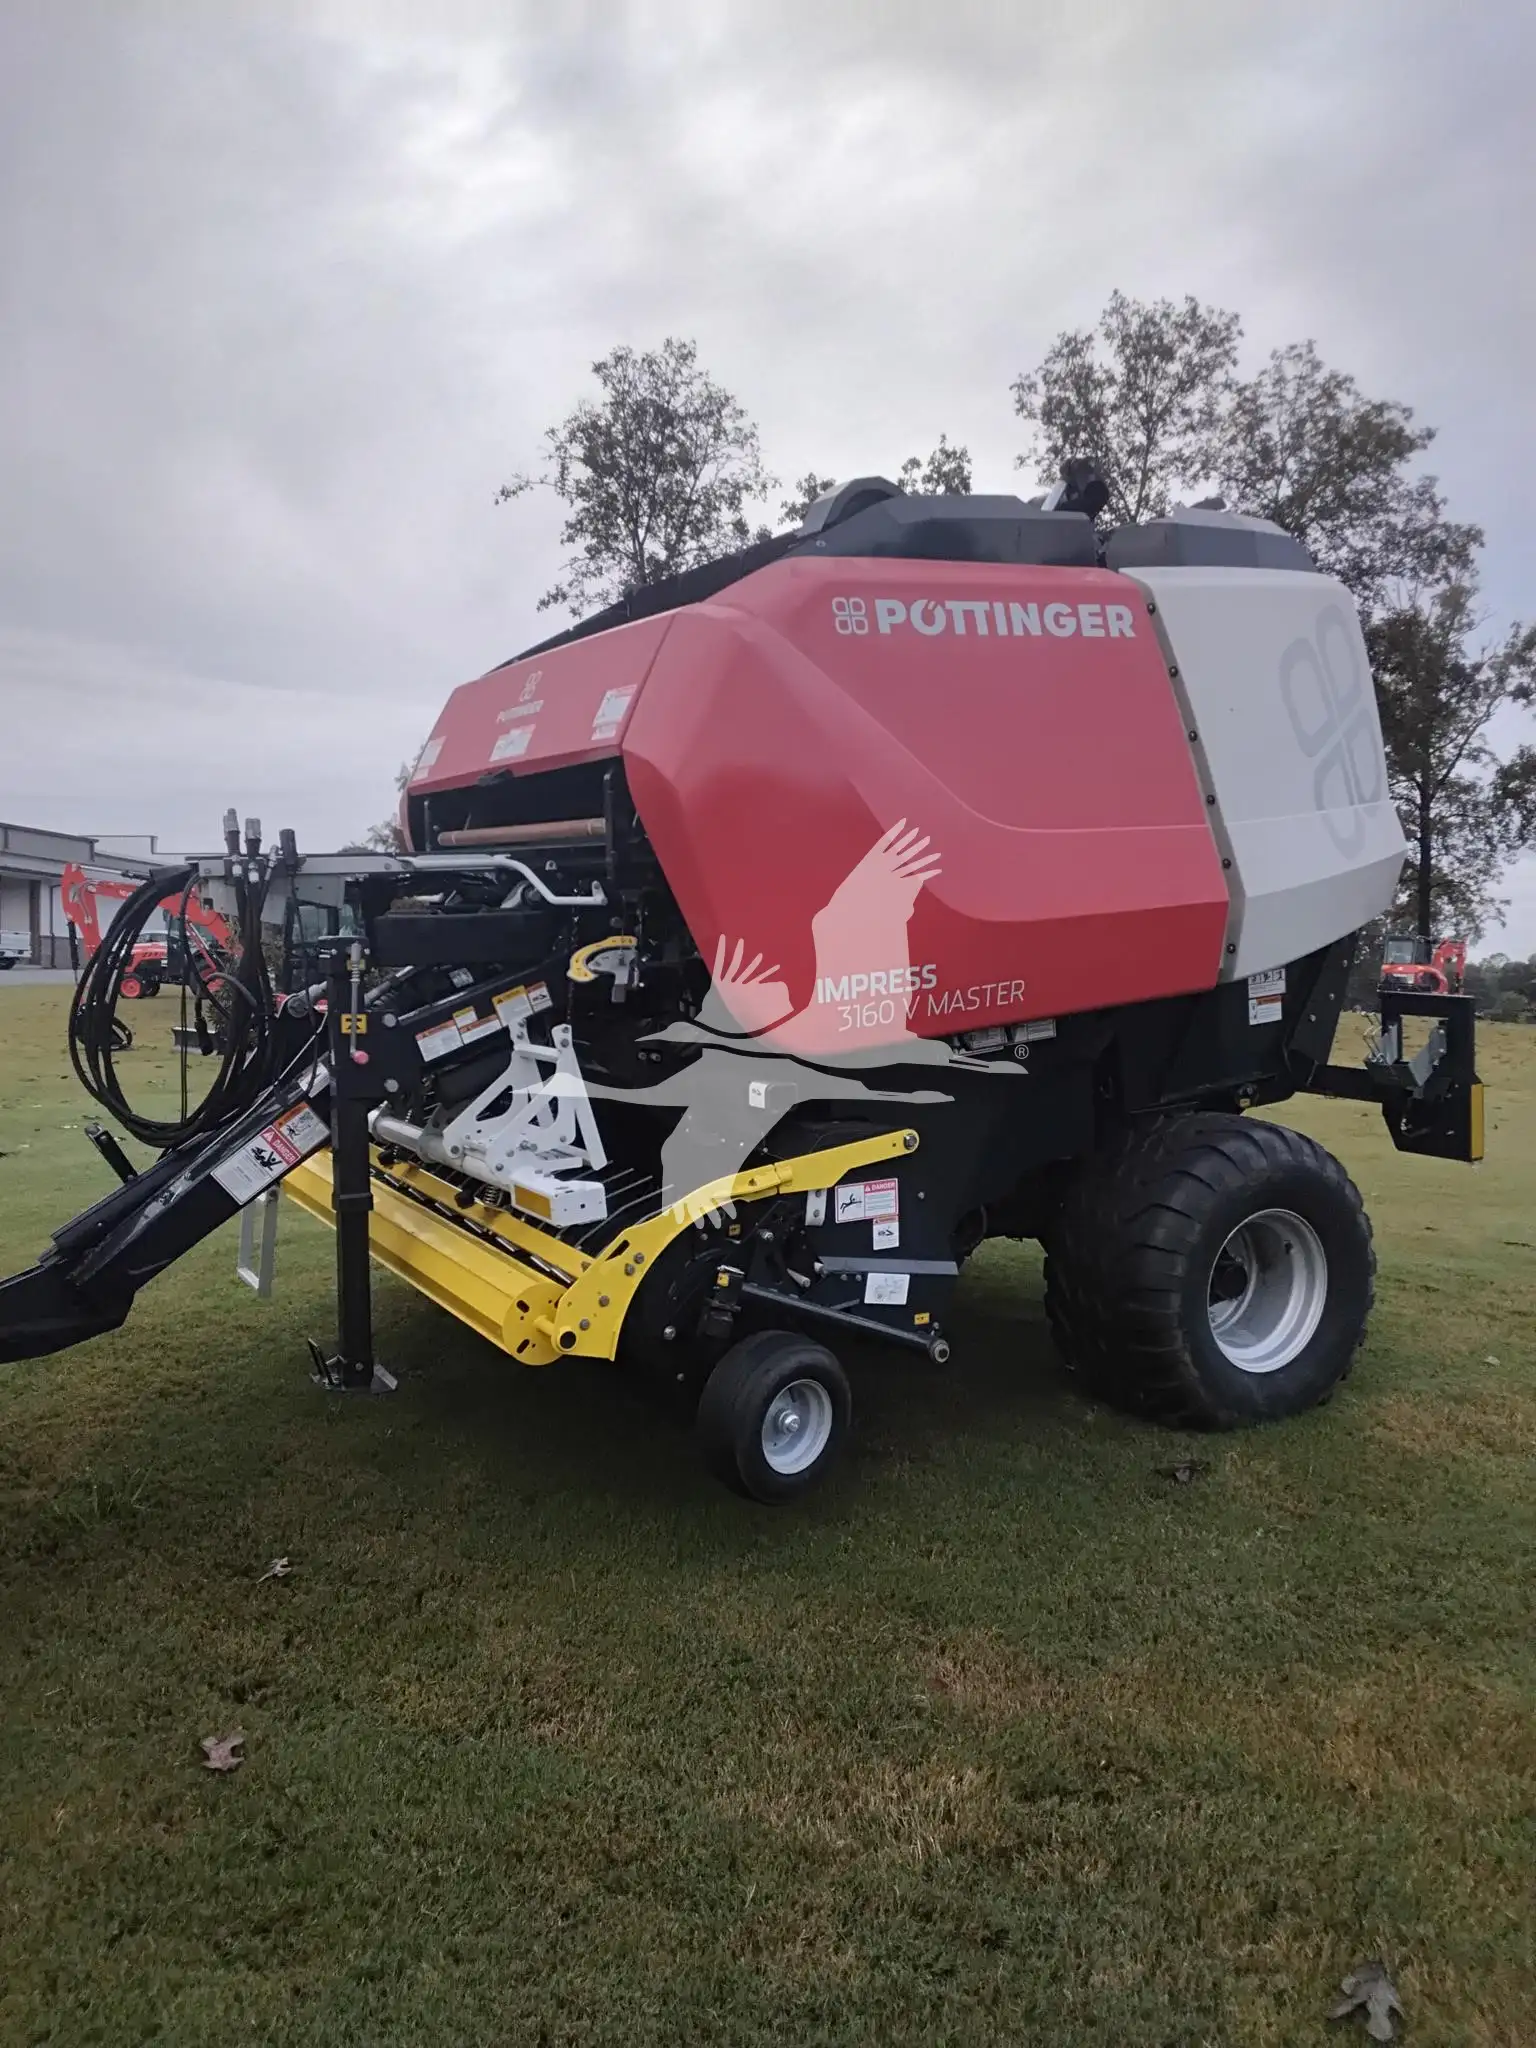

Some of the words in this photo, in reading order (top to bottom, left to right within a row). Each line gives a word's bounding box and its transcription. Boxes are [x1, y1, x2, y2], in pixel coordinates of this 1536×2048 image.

[817, 964, 937, 1003] IMPRESS
[837, 1000, 894, 1032] 3160
[905, 996, 920, 1020] V
[928, 980, 1025, 1016] MASTER
[872, 1182, 896, 1191] DANGER
